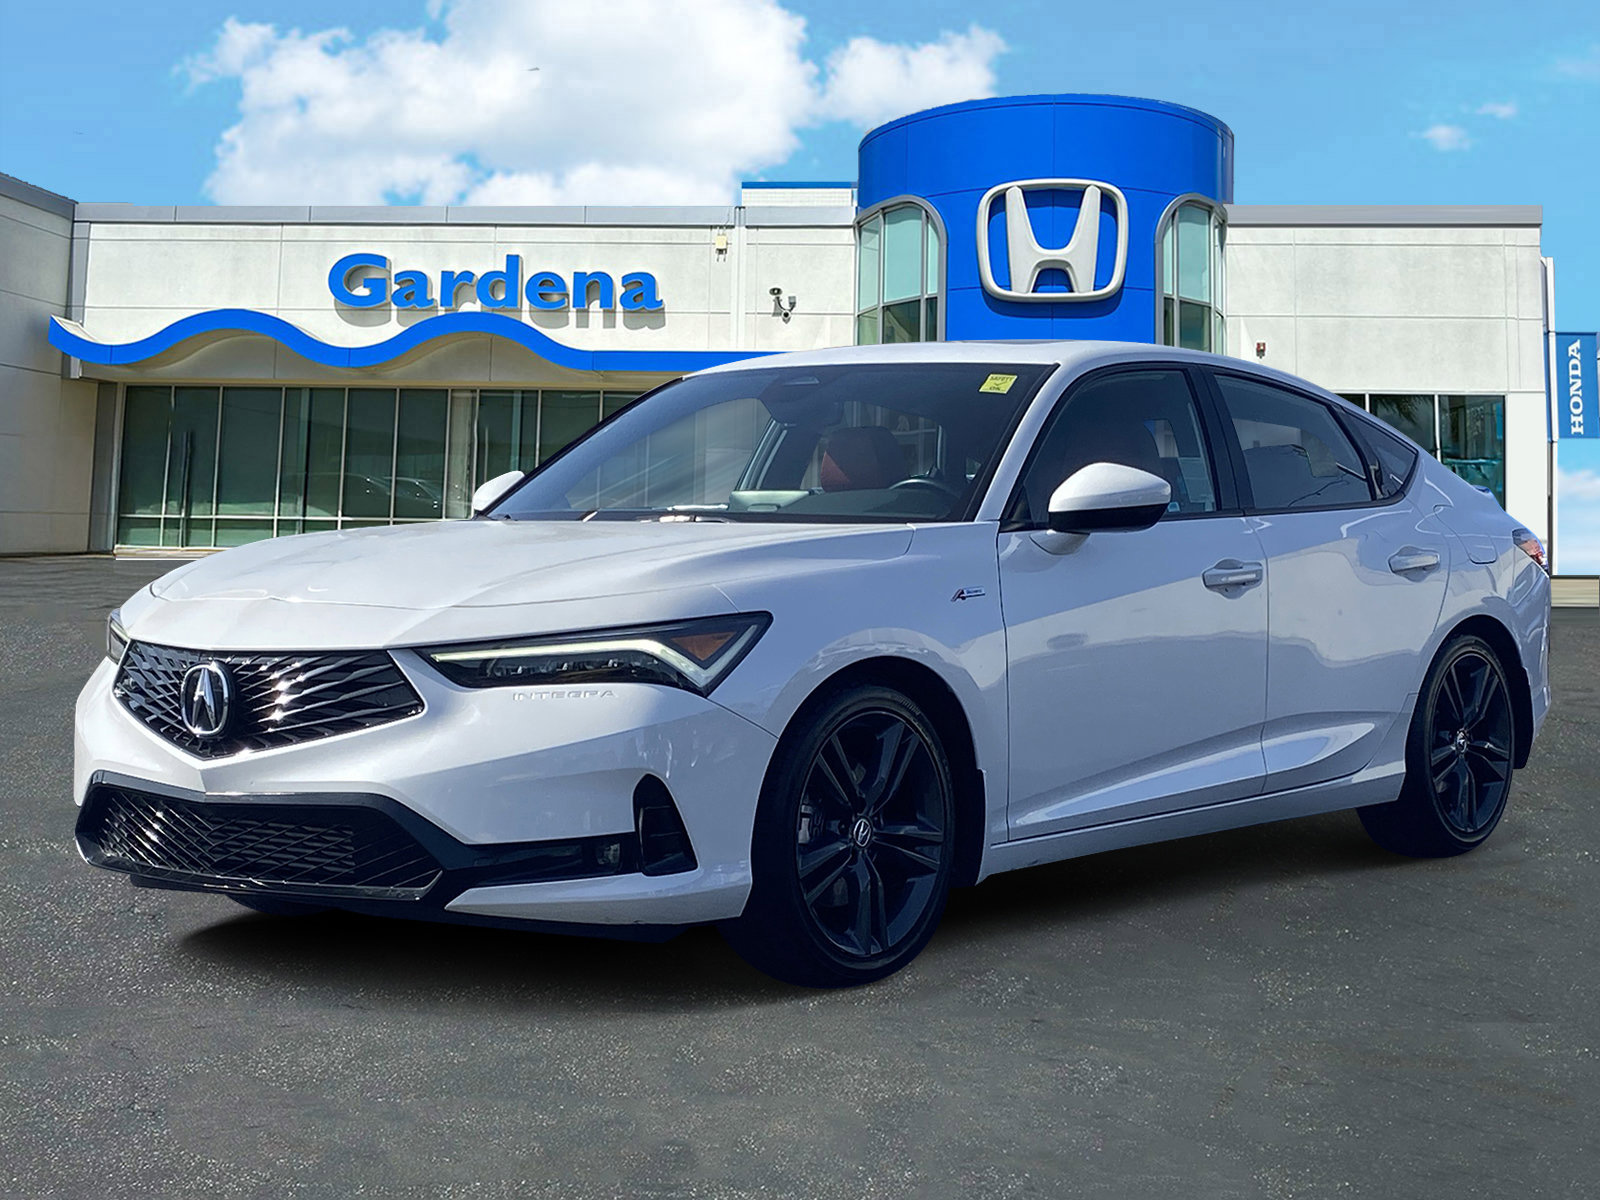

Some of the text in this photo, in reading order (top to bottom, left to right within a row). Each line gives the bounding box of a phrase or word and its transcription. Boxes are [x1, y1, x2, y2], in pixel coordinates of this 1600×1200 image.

[328, 252, 664, 311] Gardena
[1567, 339, 1584, 435] HONDA
[512, 690, 616, 701] INTEGRA
